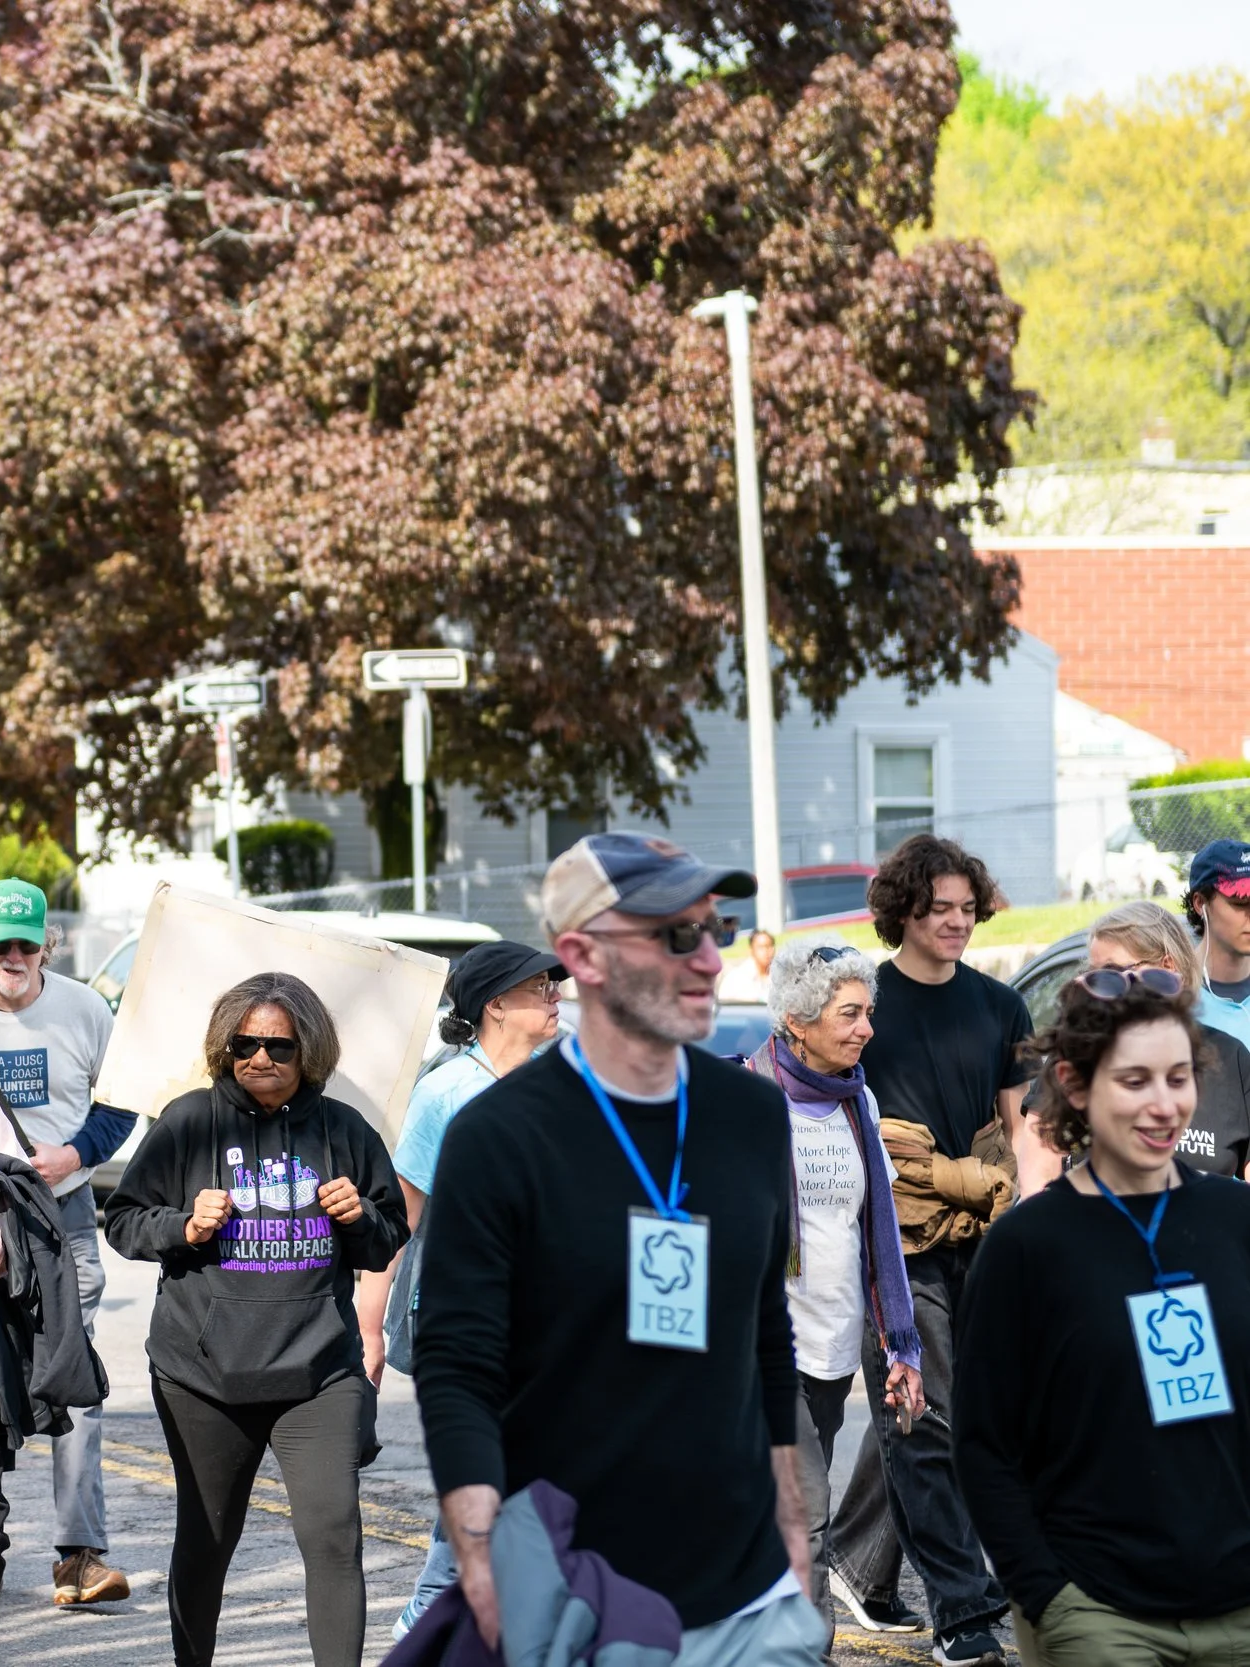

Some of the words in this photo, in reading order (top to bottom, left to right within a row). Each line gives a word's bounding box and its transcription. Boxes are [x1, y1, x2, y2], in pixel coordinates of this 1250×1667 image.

[14, 1054, 44, 1067] UUSC
[11, 1067, 44, 1079] COAST
[3, 1090, 45, 1104] GRAM
[822, 1122, 851, 1134] Throug
[1181, 1128, 1215, 1144] OWN
[797, 1147, 824, 1157] More
[827, 1145, 851, 1158] Hope
[1174, 1139, 1216, 1157] ITUTE
[805, 1163, 831, 1174] More
[833, 1161, 850, 1176] Joy
[799, 1180, 826, 1191] More
[828, 1178, 856, 1189] Peace
[801, 1196, 826, 1207] More
[829, 1195, 852, 1205] Love
[220, 1217, 303, 1241] MOTHER'S
[305, 1216, 331, 1239] DAY
[218, 1240, 260, 1259] WALK
[262, 1240, 290, 1259] FOR
[293, 1237, 334, 1258] PEACE
[220, 1258, 267, 1273] Cultivating
[268, 1259, 297, 1274] Cycles
[298, 1258, 309, 1270] of
[309, 1258, 332, 1269] Peace
[639, 1302, 695, 1336] TBZ
[1157, 1372, 1220, 1406] TBZ
